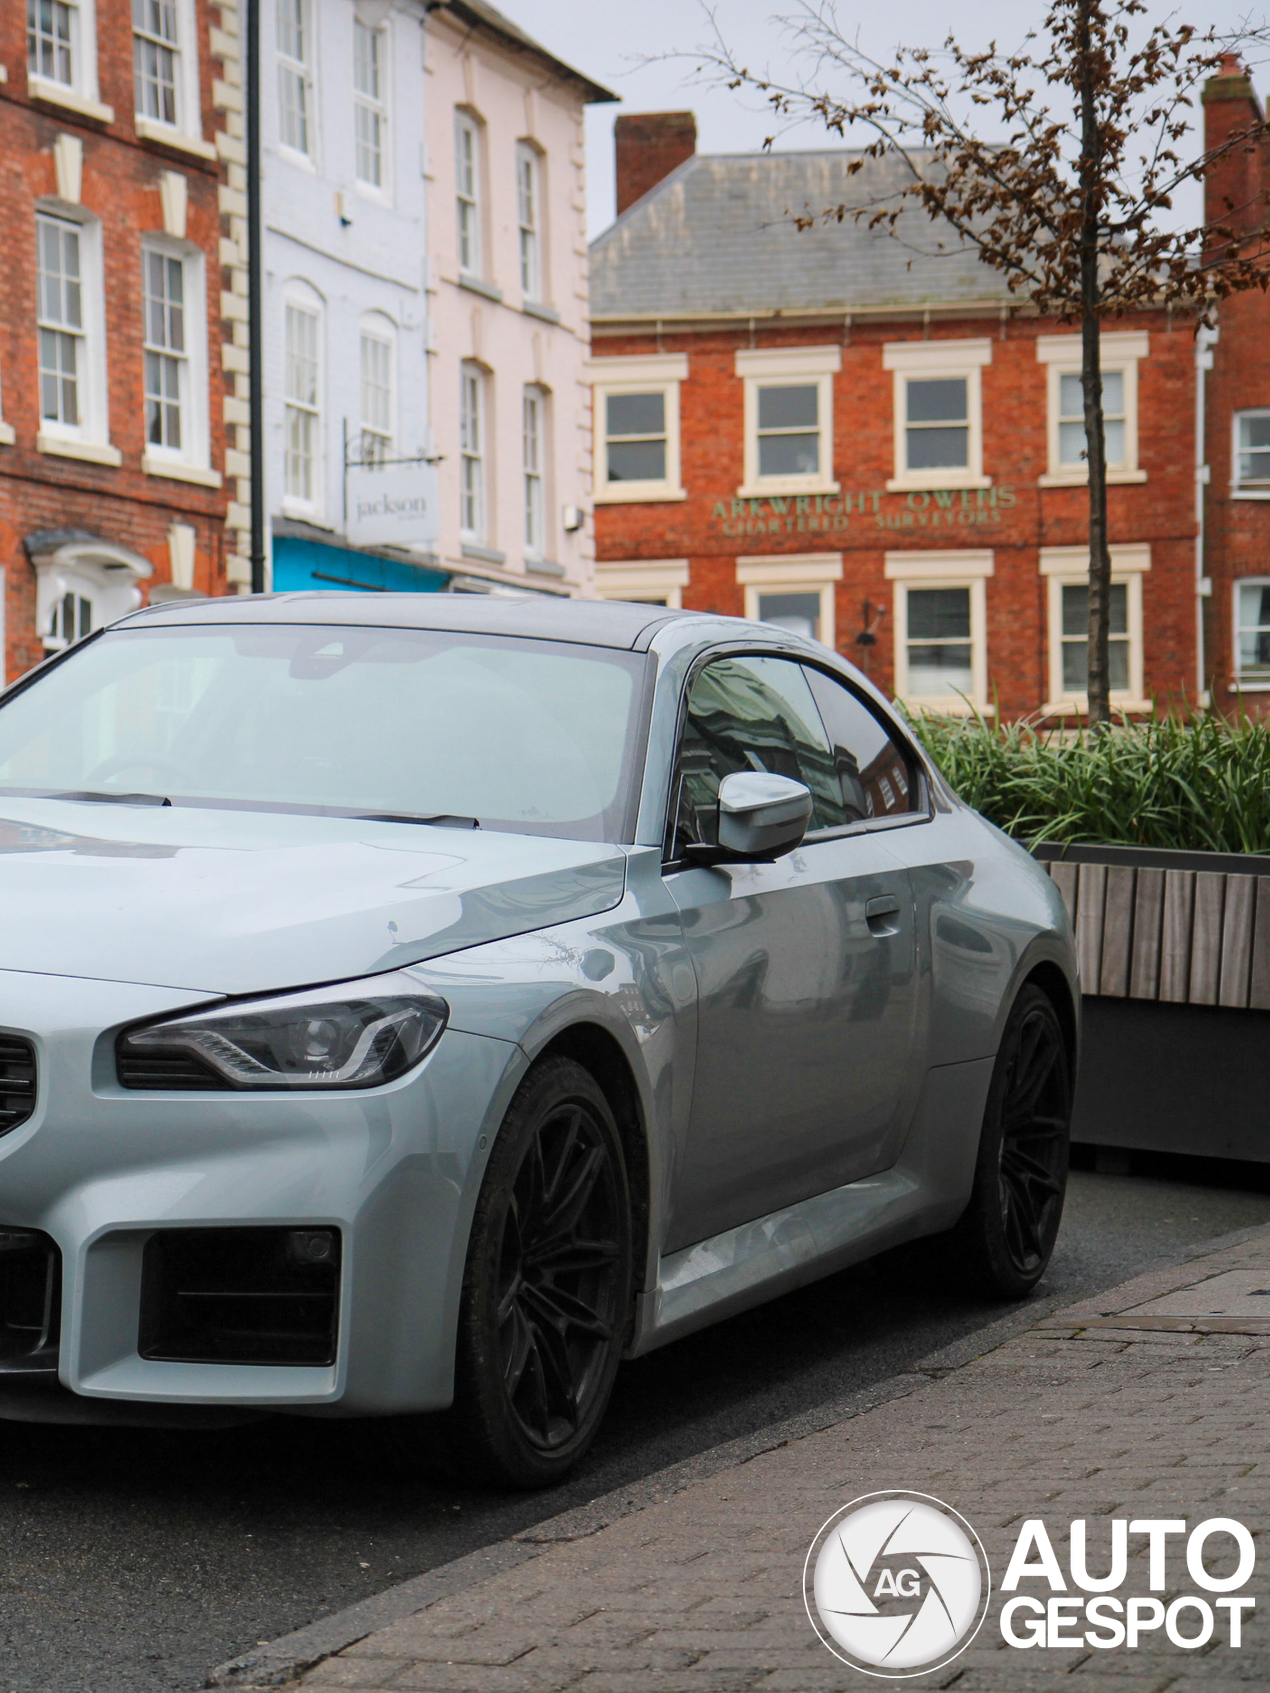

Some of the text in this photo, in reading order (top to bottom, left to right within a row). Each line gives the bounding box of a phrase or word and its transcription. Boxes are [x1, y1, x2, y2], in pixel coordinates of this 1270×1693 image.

[356, 493, 427, 523] jackson
[711, 485, 1018, 520] ARKWRIGHT OWENS
[722, 509, 1001, 537] CHARTERED SURVEYORS
